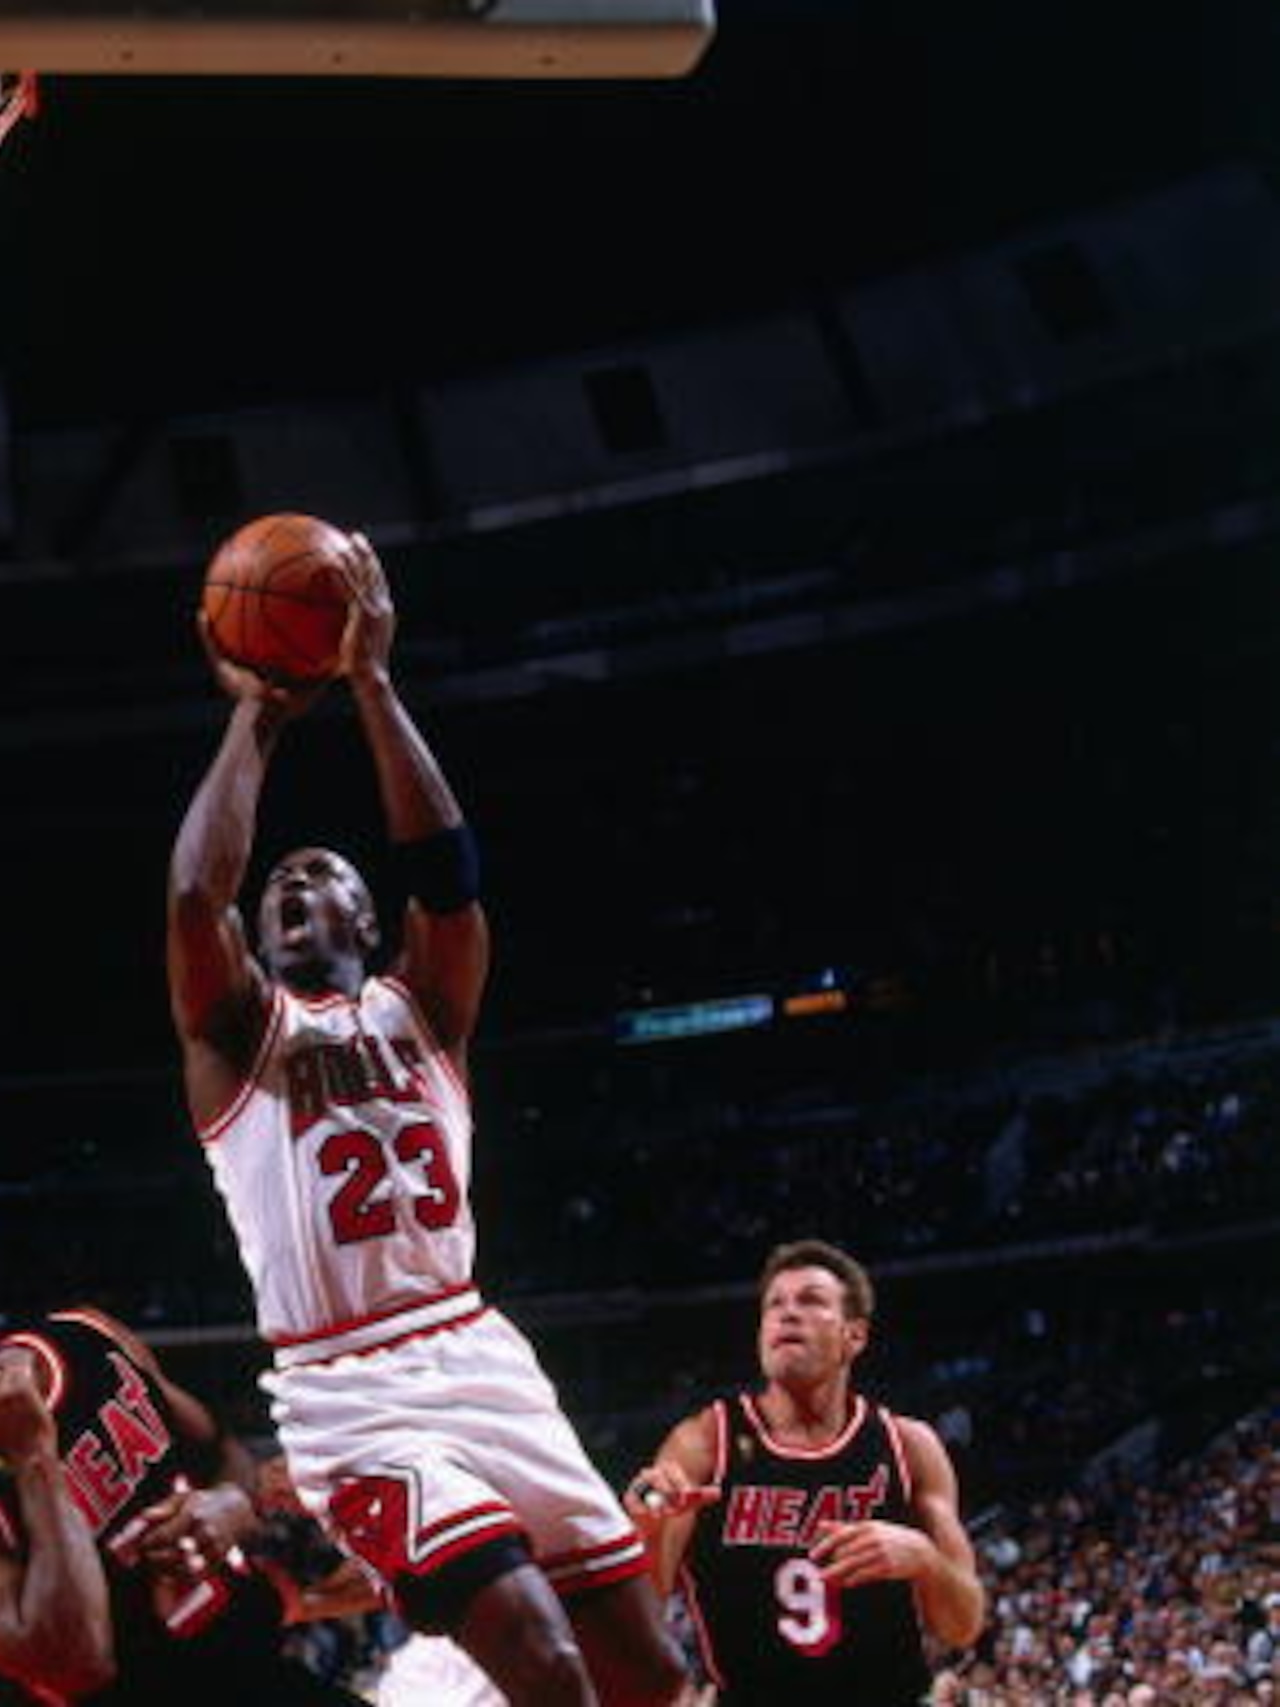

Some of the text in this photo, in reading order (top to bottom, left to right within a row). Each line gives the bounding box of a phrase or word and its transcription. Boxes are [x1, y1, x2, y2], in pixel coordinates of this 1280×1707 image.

[317, 1122, 460, 1245] 23
[722, 1464, 889, 1547] HEAT
[776, 1557, 840, 1655] 9
